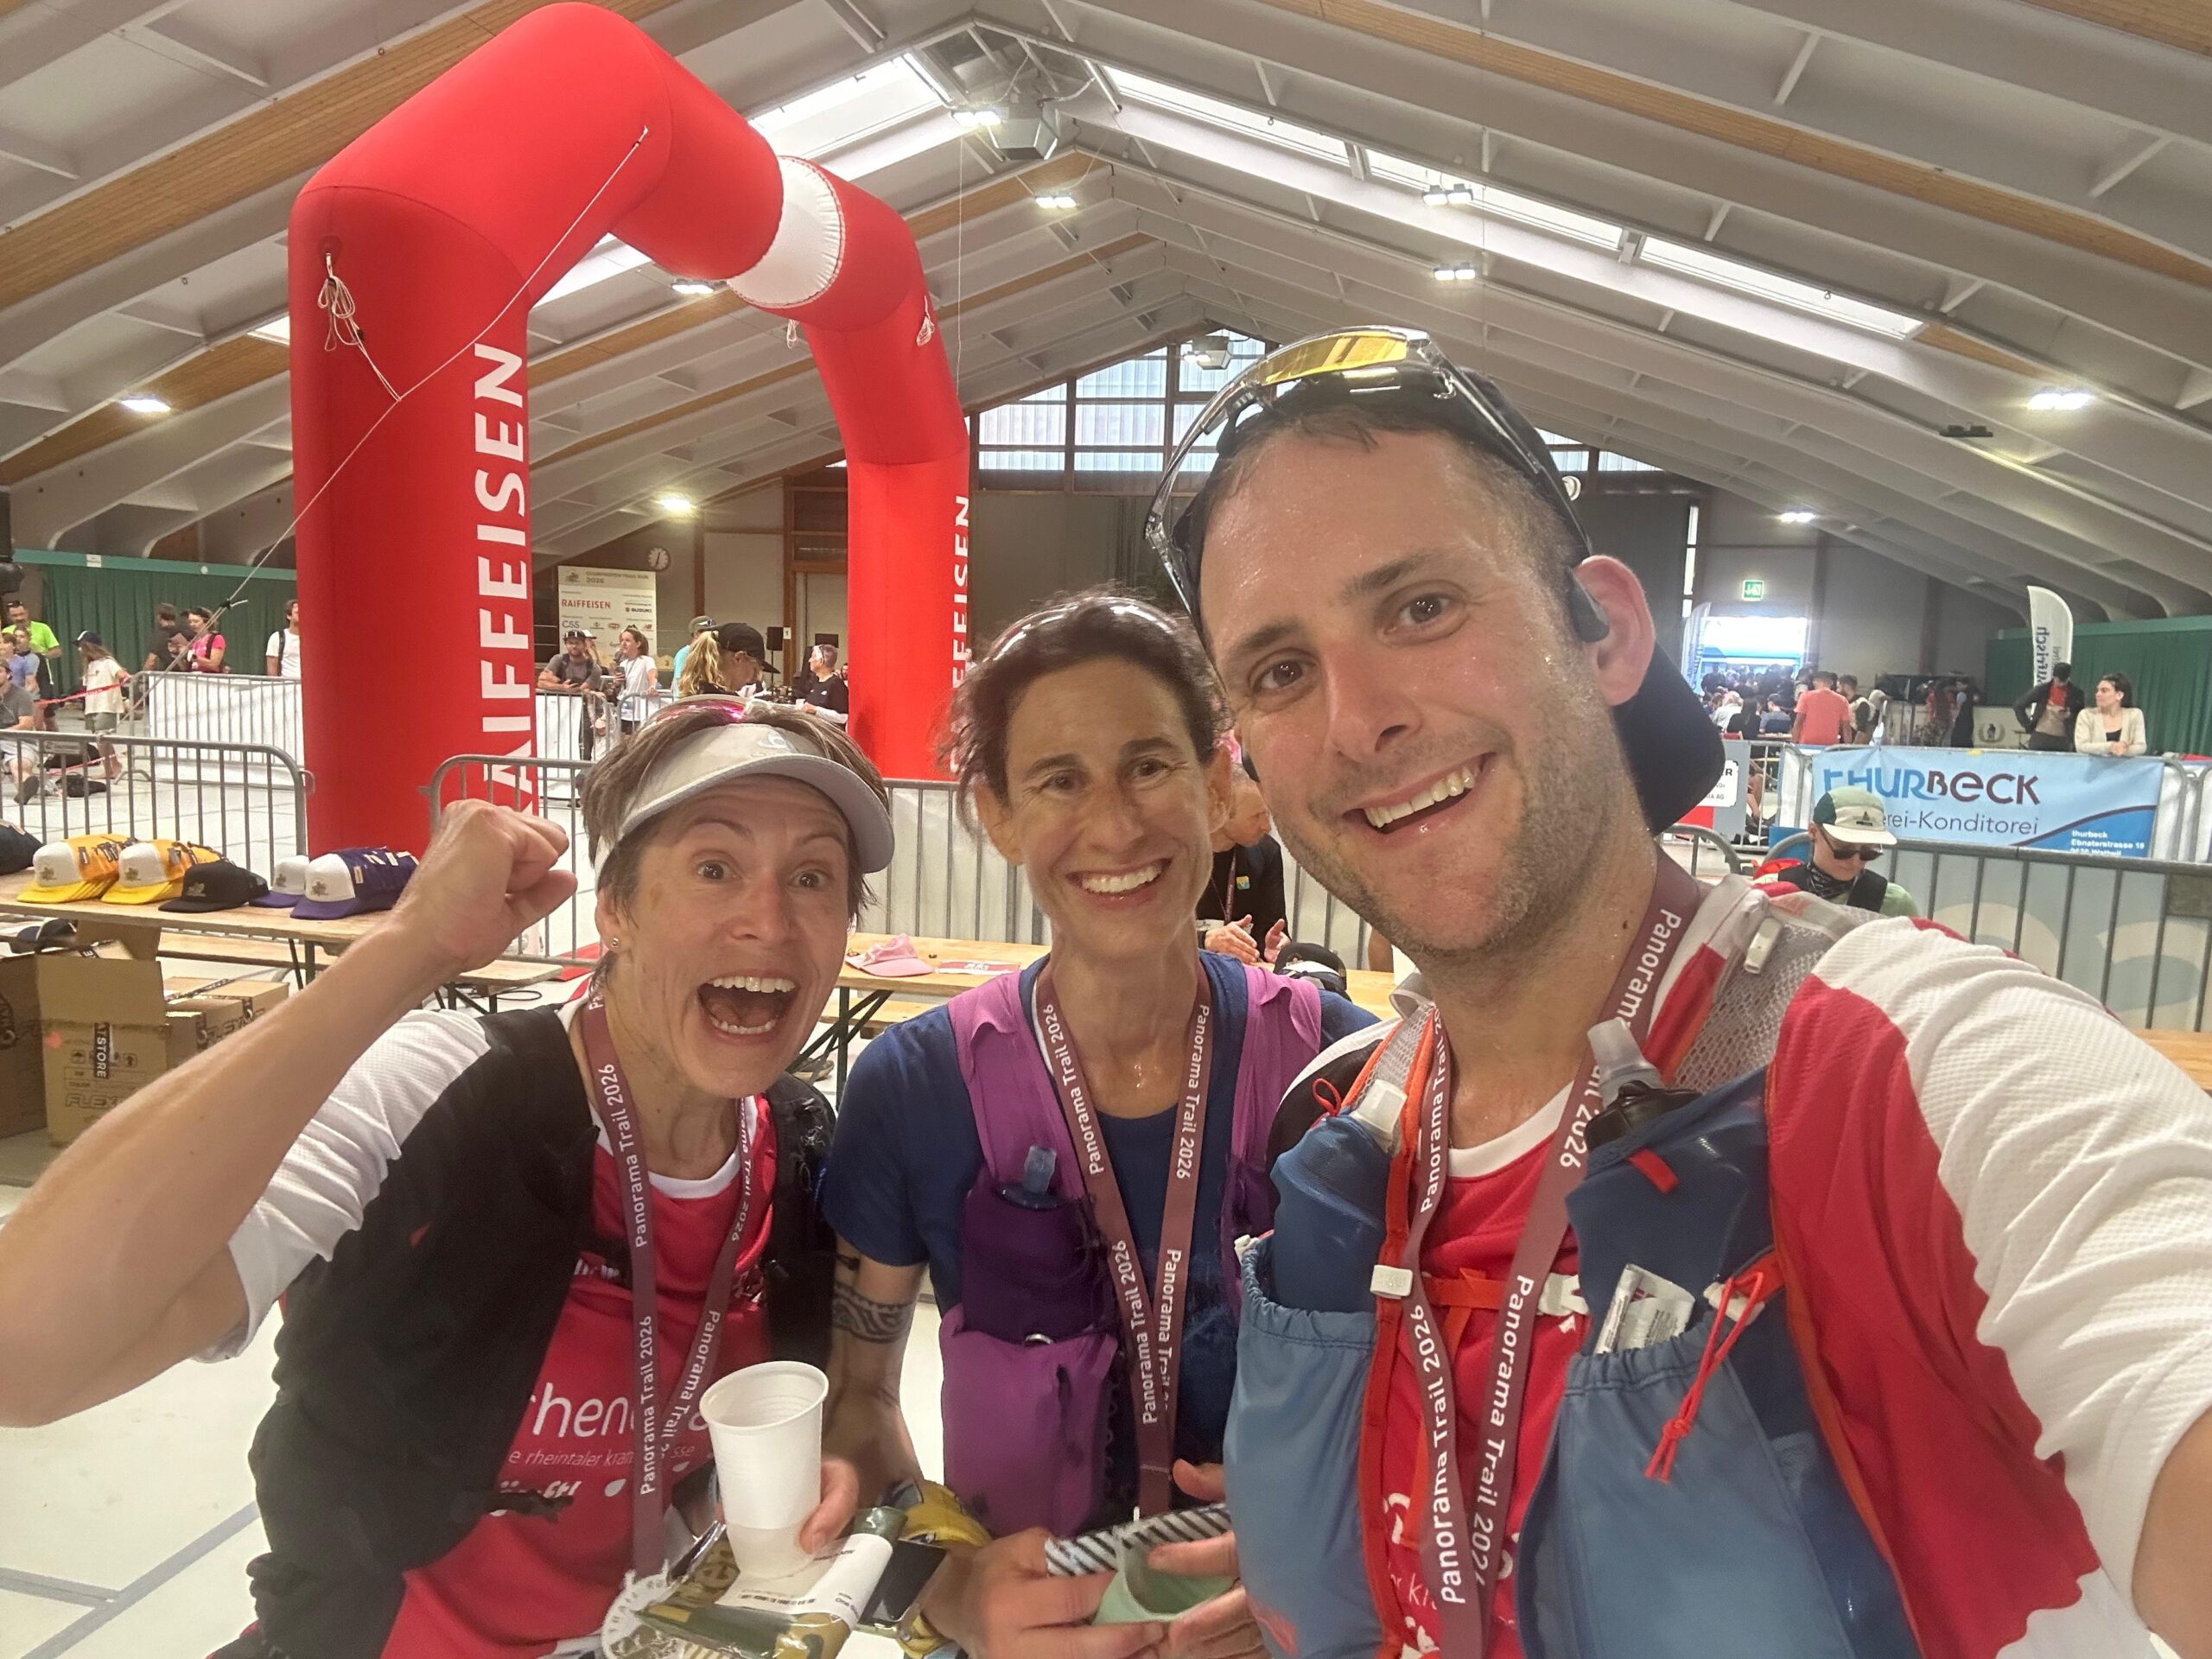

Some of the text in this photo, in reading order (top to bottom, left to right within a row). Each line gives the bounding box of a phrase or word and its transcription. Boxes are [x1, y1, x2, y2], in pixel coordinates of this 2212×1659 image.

[474, 343, 533, 814] AIFFEISEN
[561, 599, 612, 609] RAIFFEISEN
[562, 620, 580, 629] CSS
[951, 495, 969, 691] FFEISEN
[2072, 830, 2108, 838] thurbeck
[1618, 908, 1683, 1031] Panoram
[597, 1063, 648, 1248] Panorama Trail 2026
[1043, 1003, 1104, 1175] Panorama Trail 2026
[1176, 1004, 1210, 1180] Panorama Trail 2026
[1420, 1091, 1445, 1213] Panorama
[1433, 1036, 1446, 1090] Trail
[731, 1201, 749, 1243] 2026
[1158, 1249, 1182, 1343] Panorama
[639, 1315, 656, 1495] Panorama Trail 2026
[680, 1310, 721, 1401] Panorama
[1111, 1240, 1158, 1425] Panorama Trail 2026
[524, 1449, 601, 1467] rheintaler
[661, 1405, 690, 1438] Trail
[1409, 1304, 1466, 1605] Panorama Trail 2026
[1471, 1274, 1535, 1586] Panorama Trail 202
